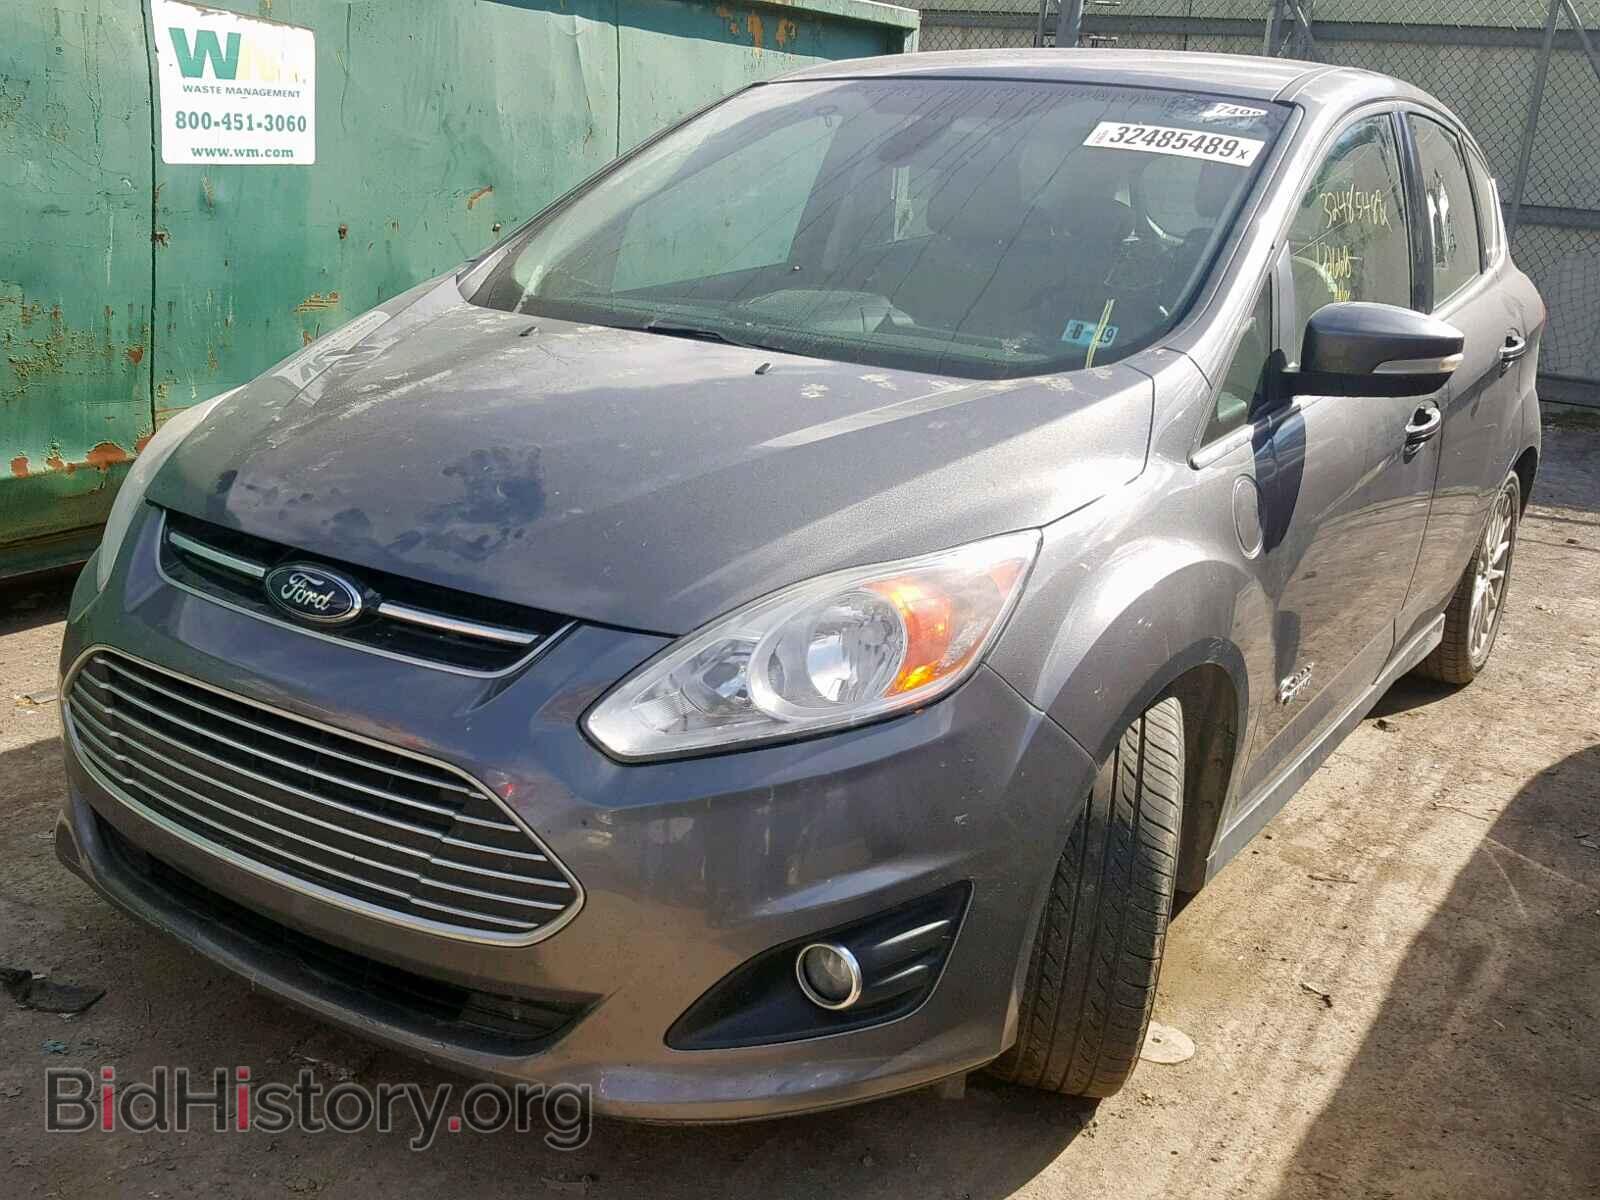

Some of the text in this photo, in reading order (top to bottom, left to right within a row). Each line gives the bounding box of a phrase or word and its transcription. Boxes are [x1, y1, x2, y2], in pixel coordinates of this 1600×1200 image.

[182, 85, 302, 99] WASTE MANAGEMENT
[175, 110, 307, 133] 800-451-3060
[190, 146, 294, 159] www.wm.com
[1109, 126, 1239, 158] 32485489
[281, 572, 336, 611] Ford
